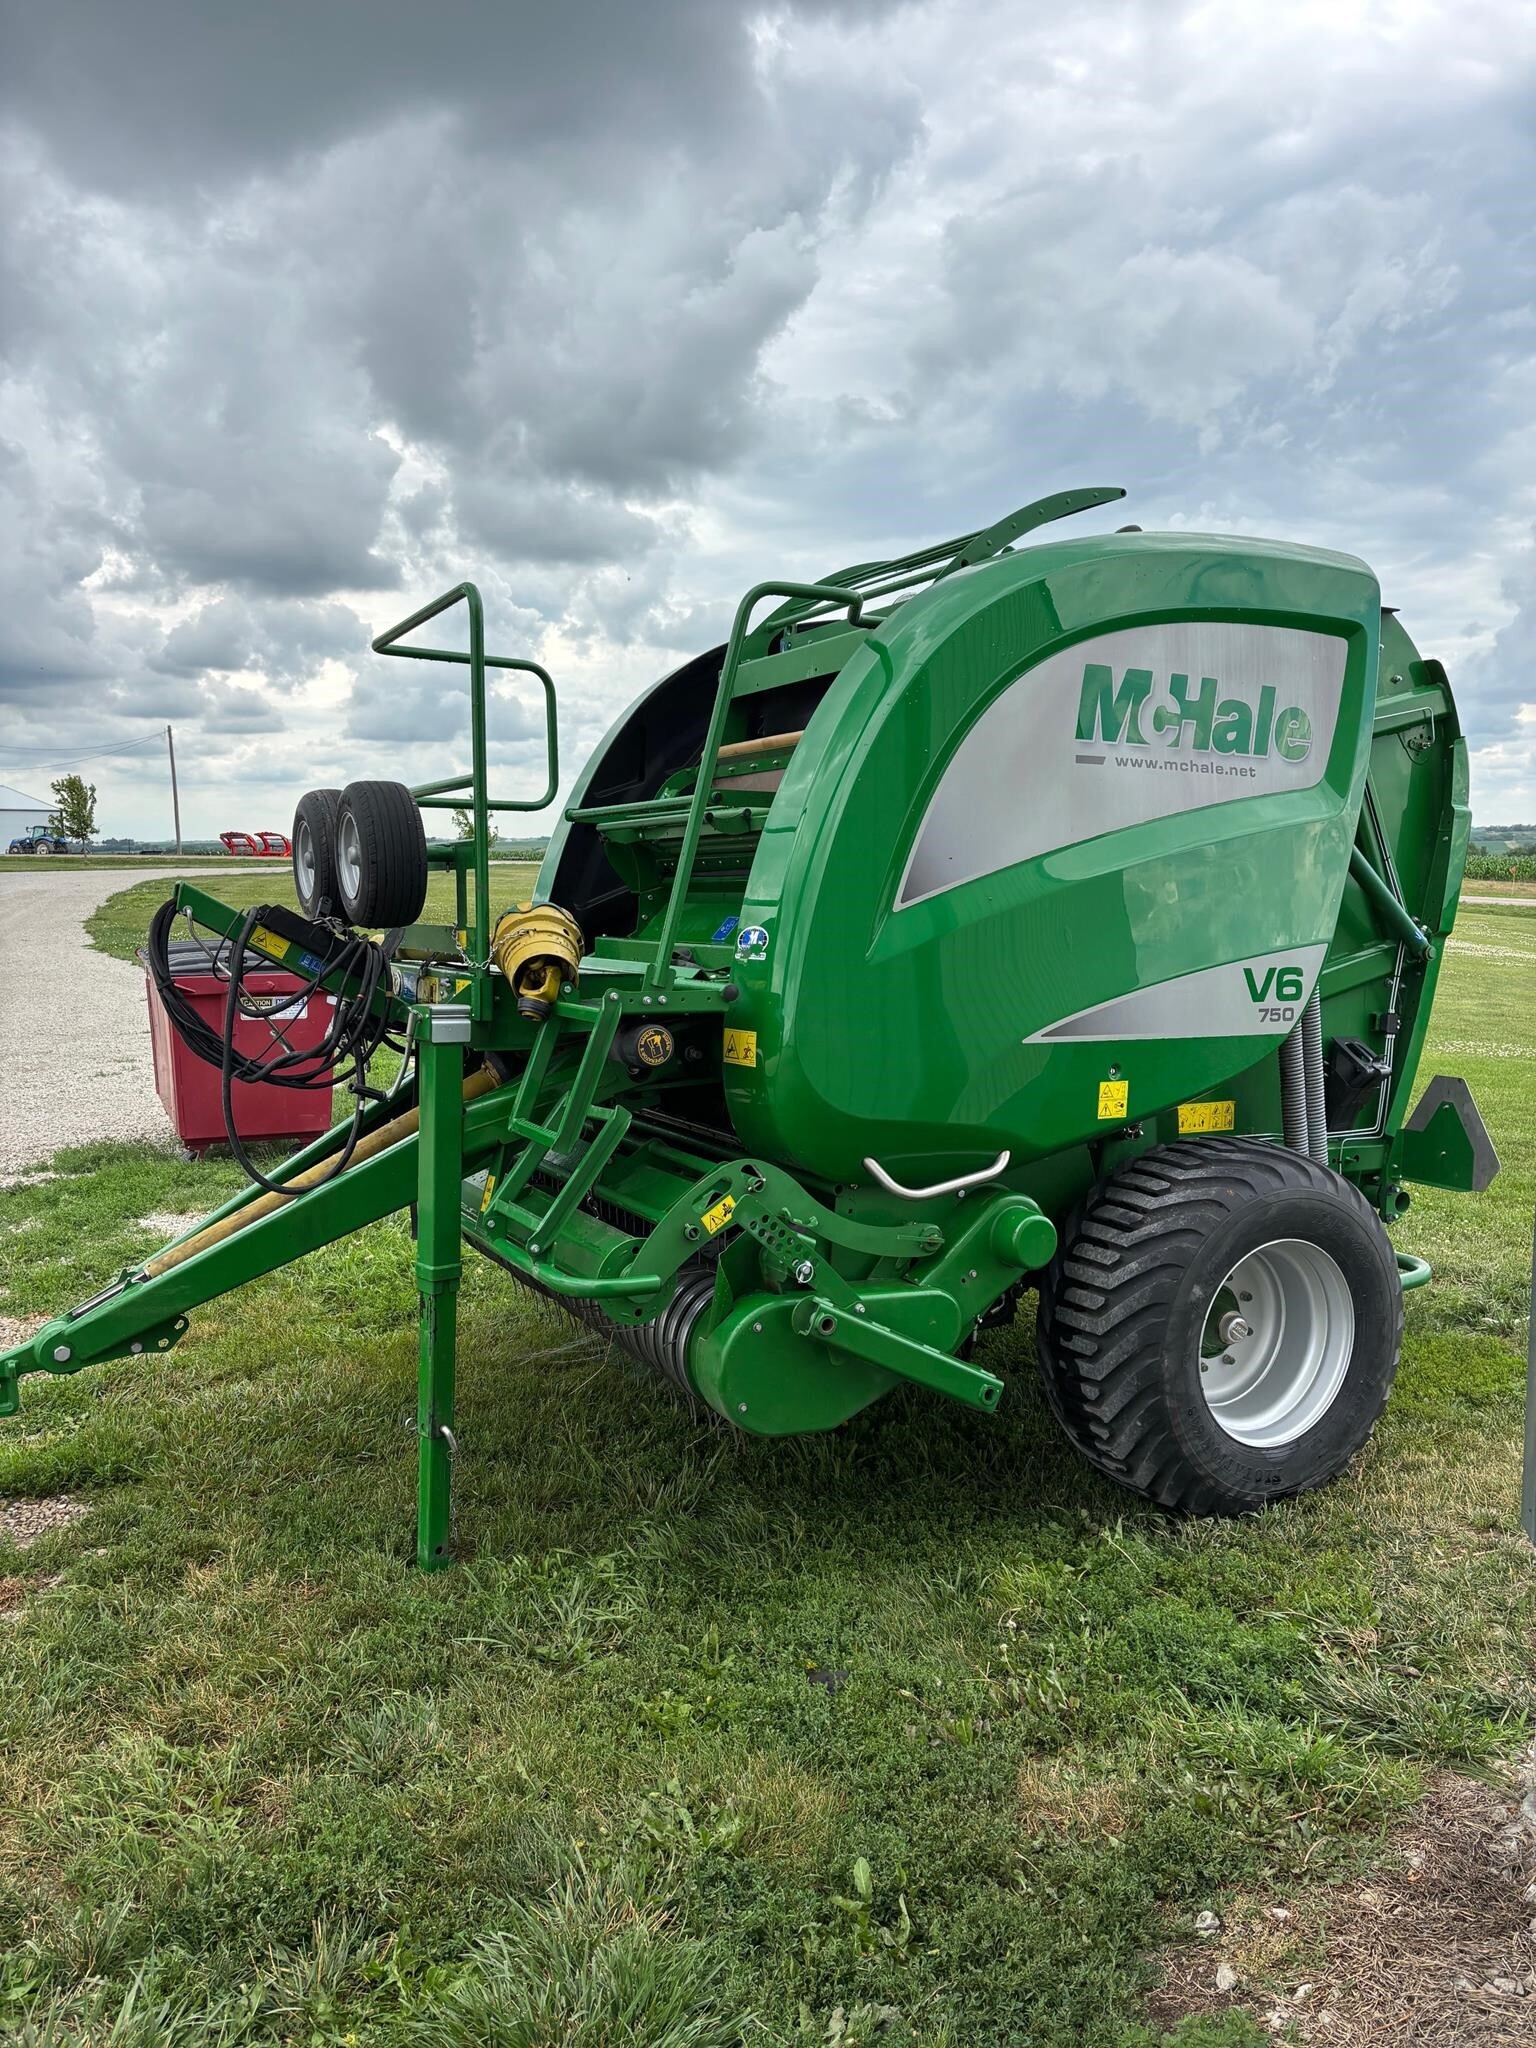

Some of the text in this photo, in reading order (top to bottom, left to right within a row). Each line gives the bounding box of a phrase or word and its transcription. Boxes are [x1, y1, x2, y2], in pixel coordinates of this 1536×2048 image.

[1114, 755, 1257, 778] www.mchale.net
[1242, 966, 1304, 1003] V6
[243, 999, 271, 1007] CATION
[1258, 1007, 1295, 1022] 750
